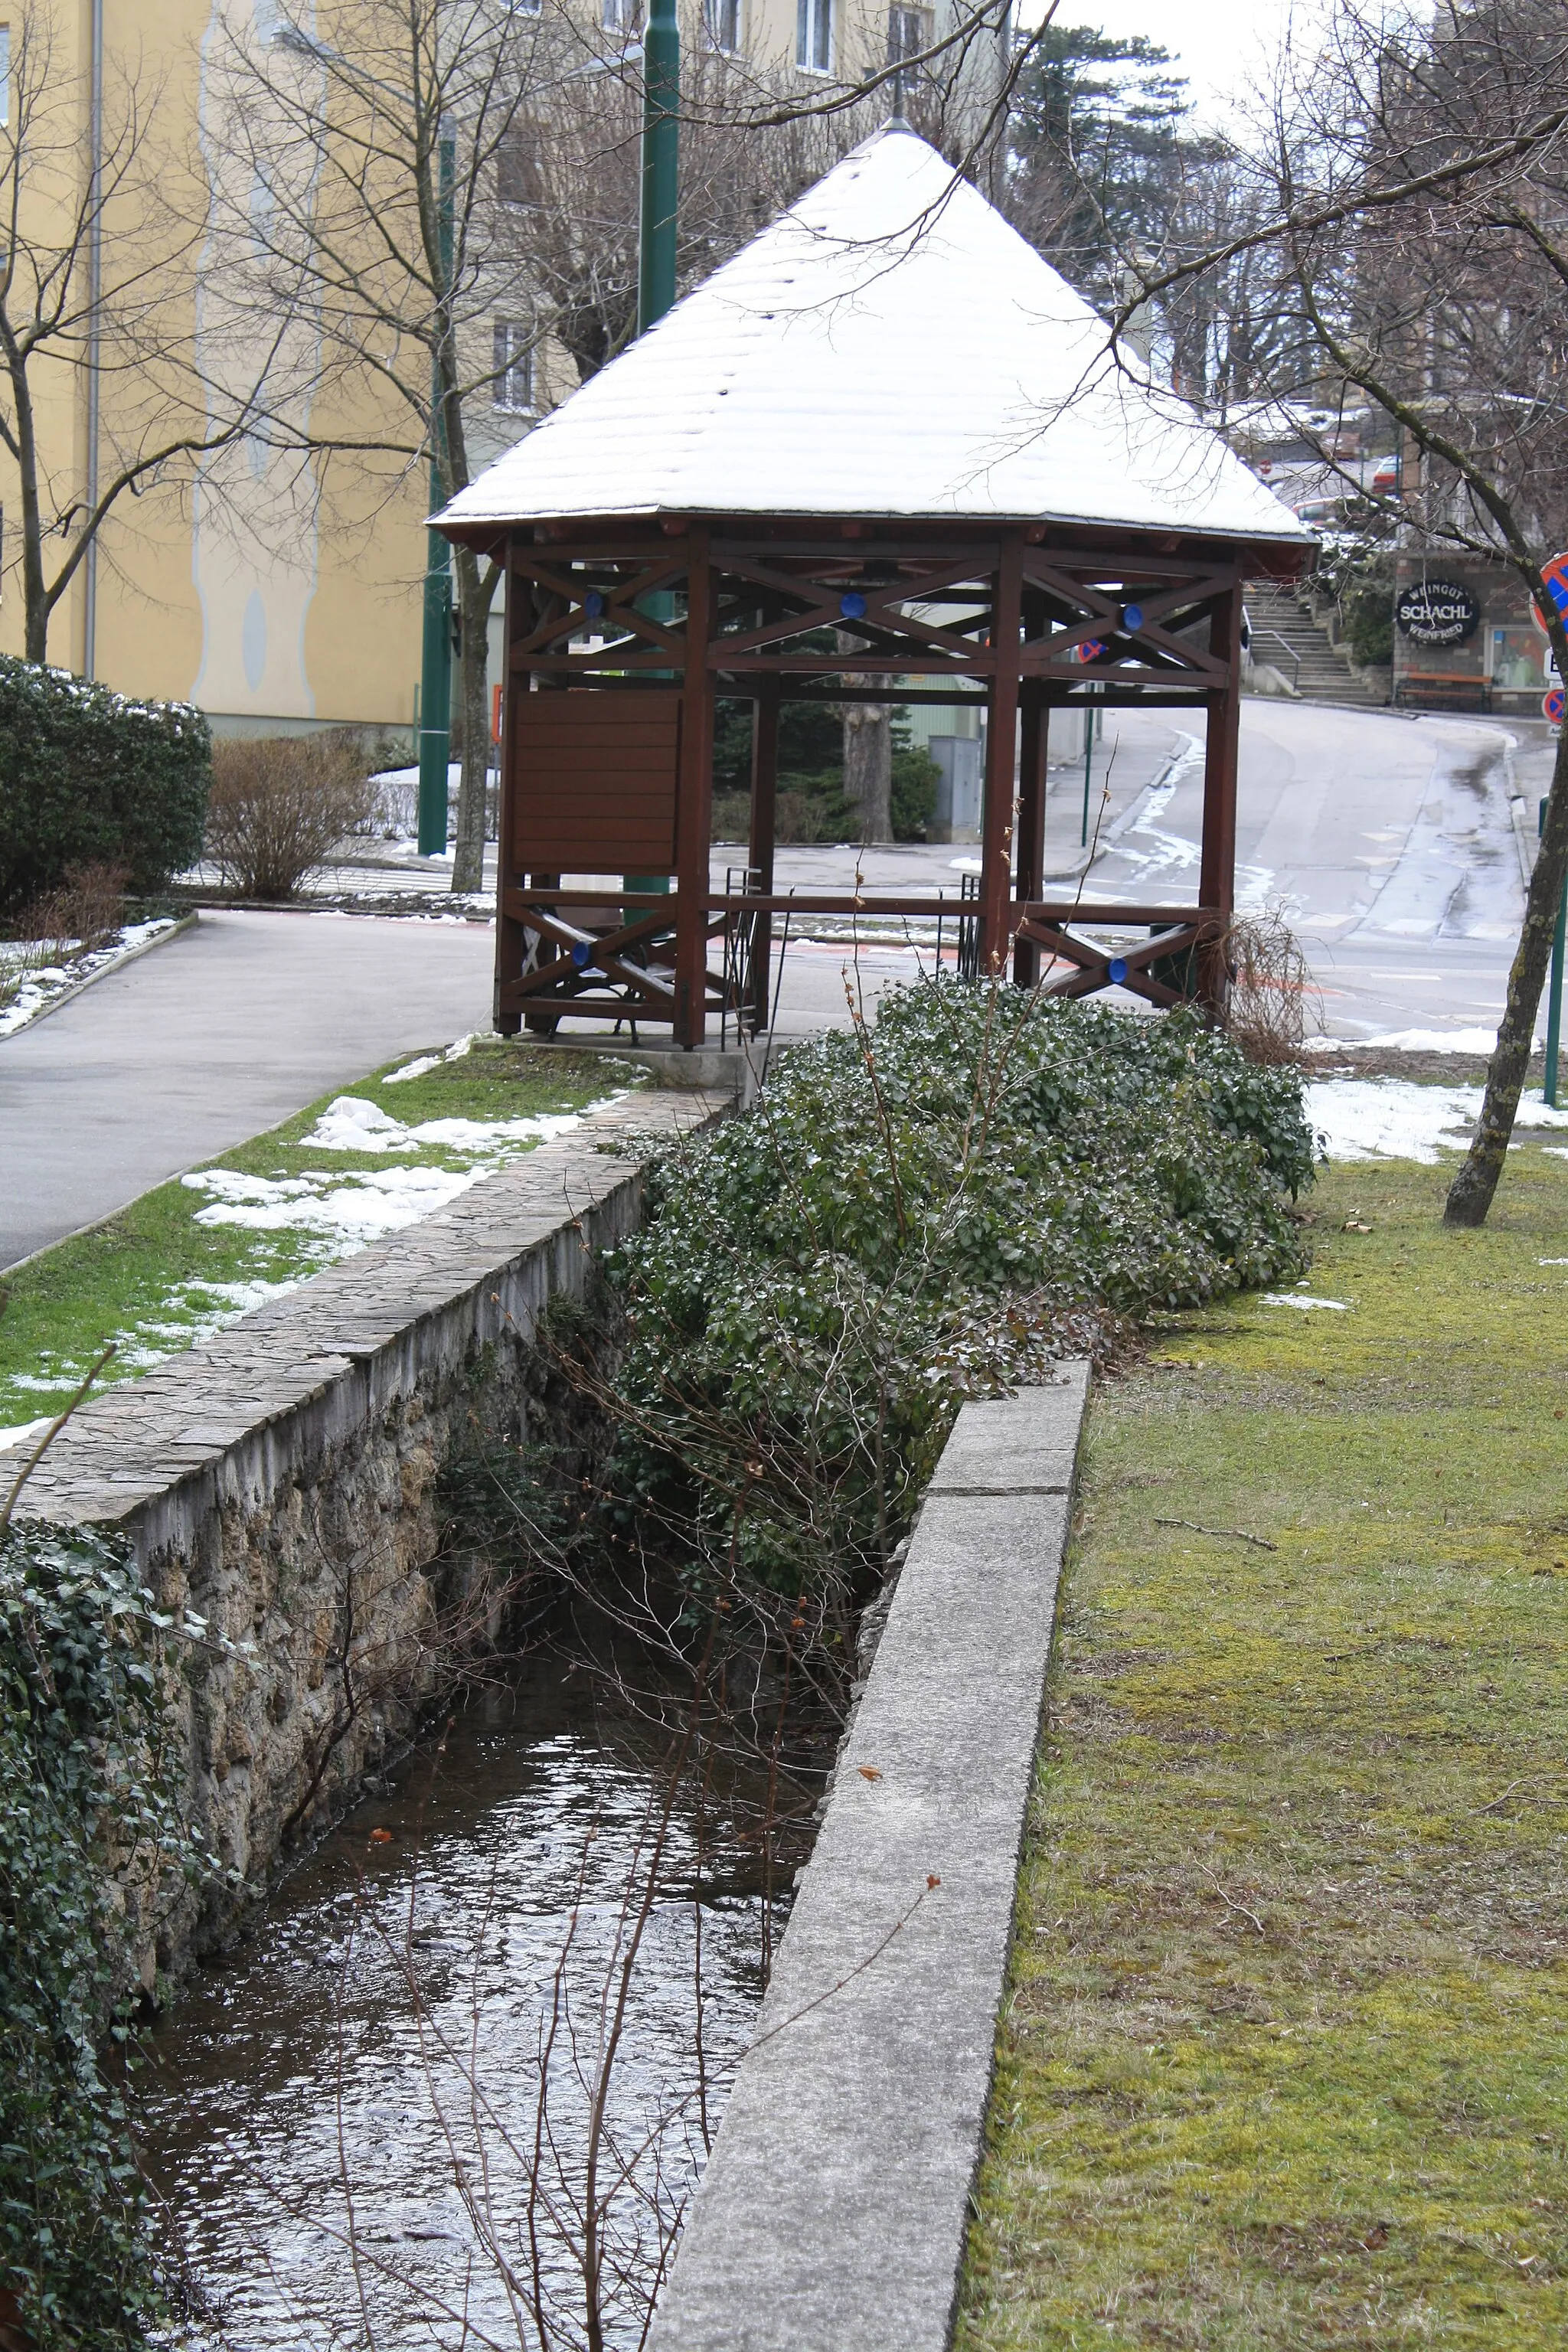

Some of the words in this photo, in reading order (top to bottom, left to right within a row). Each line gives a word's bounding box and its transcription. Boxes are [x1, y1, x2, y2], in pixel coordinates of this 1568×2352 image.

[1410, 584, 1463, 600] WEINGUT
[1400, 605, 1470, 619] SCHACHL
[1410, 623, 1463, 639] WEINFRIED
